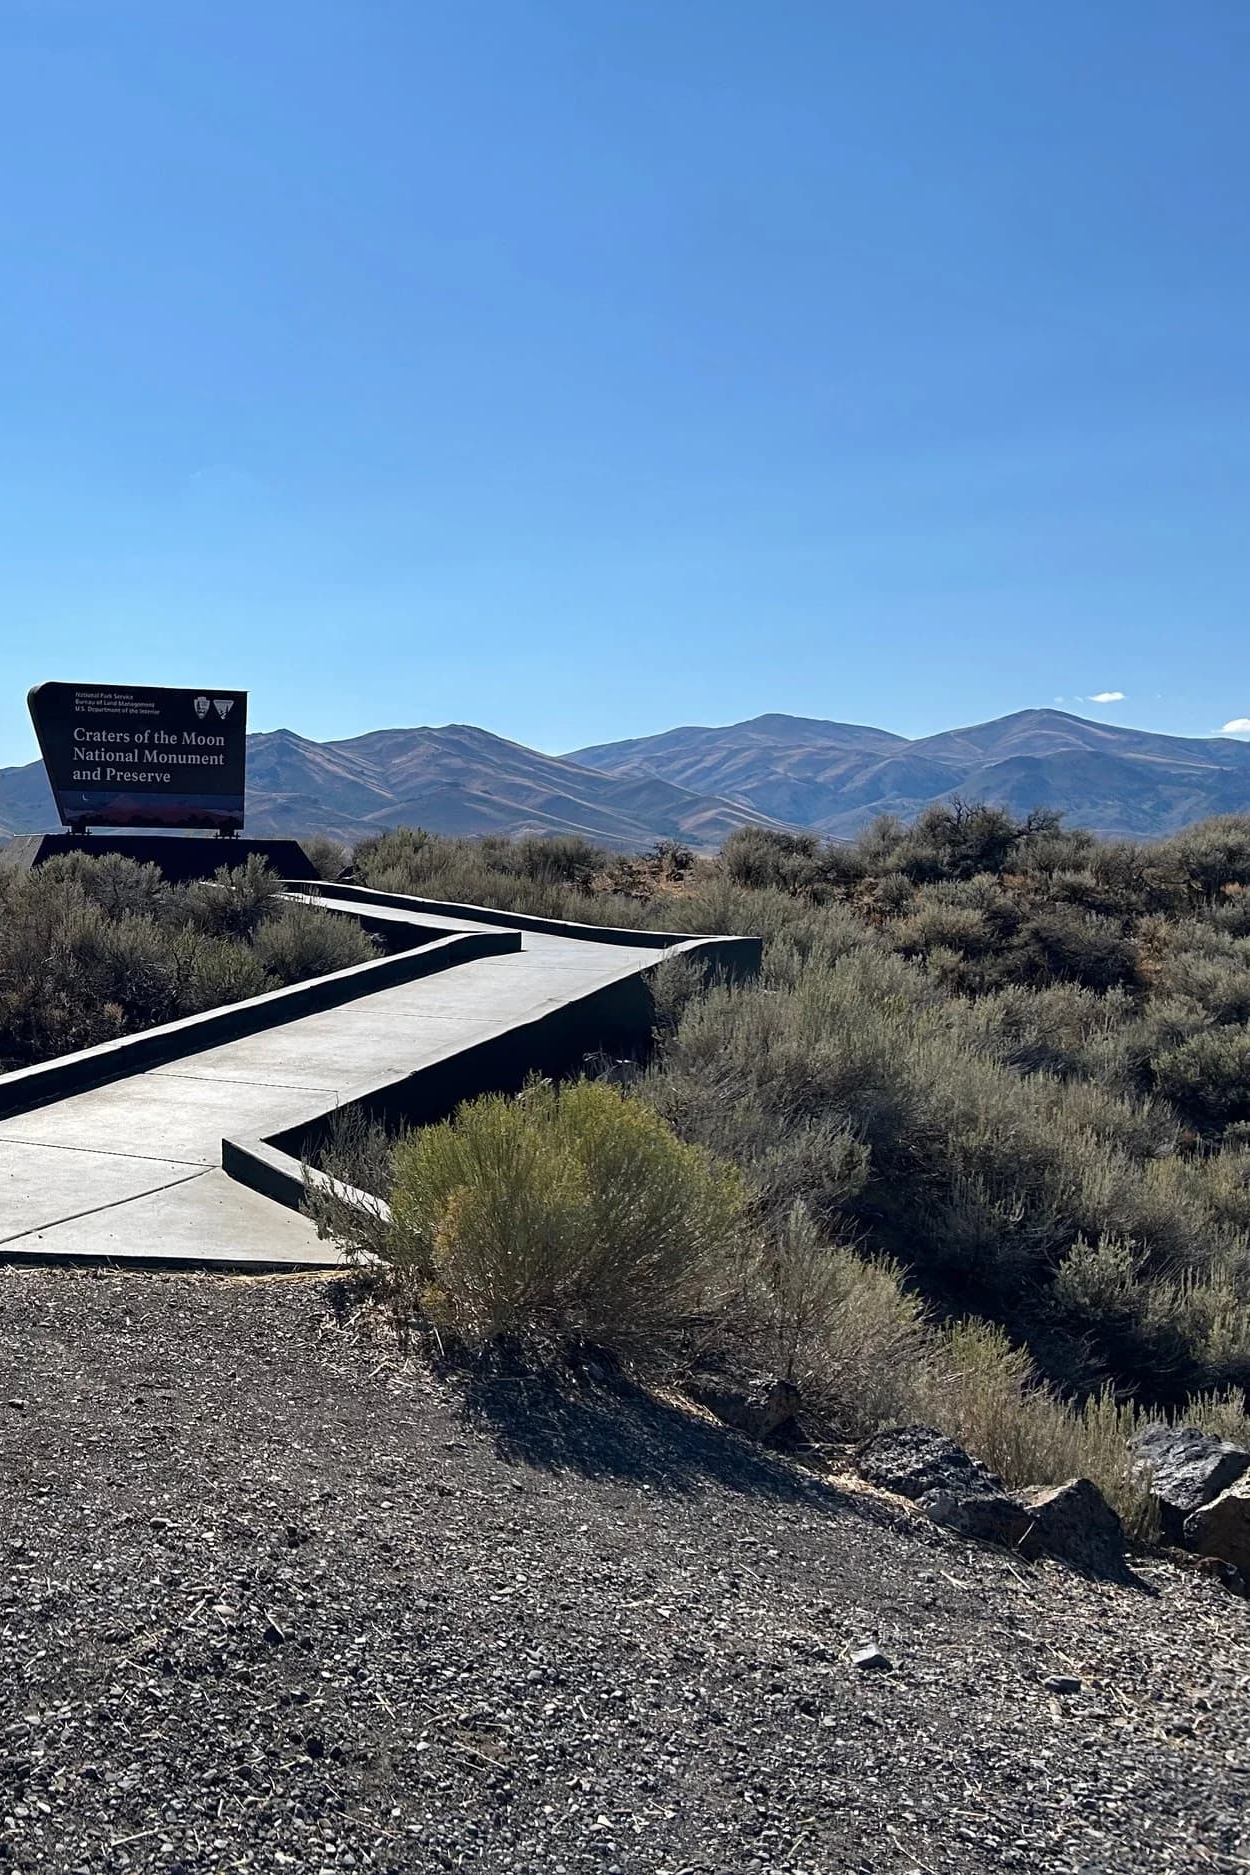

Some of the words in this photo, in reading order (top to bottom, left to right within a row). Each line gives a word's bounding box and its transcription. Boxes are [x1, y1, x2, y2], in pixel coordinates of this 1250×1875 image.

[73, 727, 130, 743] Craters
[134, 729, 151, 744] of
[154, 730, 178, 744] the
[181, 731, 225, 746] Moon
[72, 747, 139, 763] National
[143, 749, 225, 765] Monument
[72, 767, 101, 781] and
[106, 767, 171, 783] Preserve
